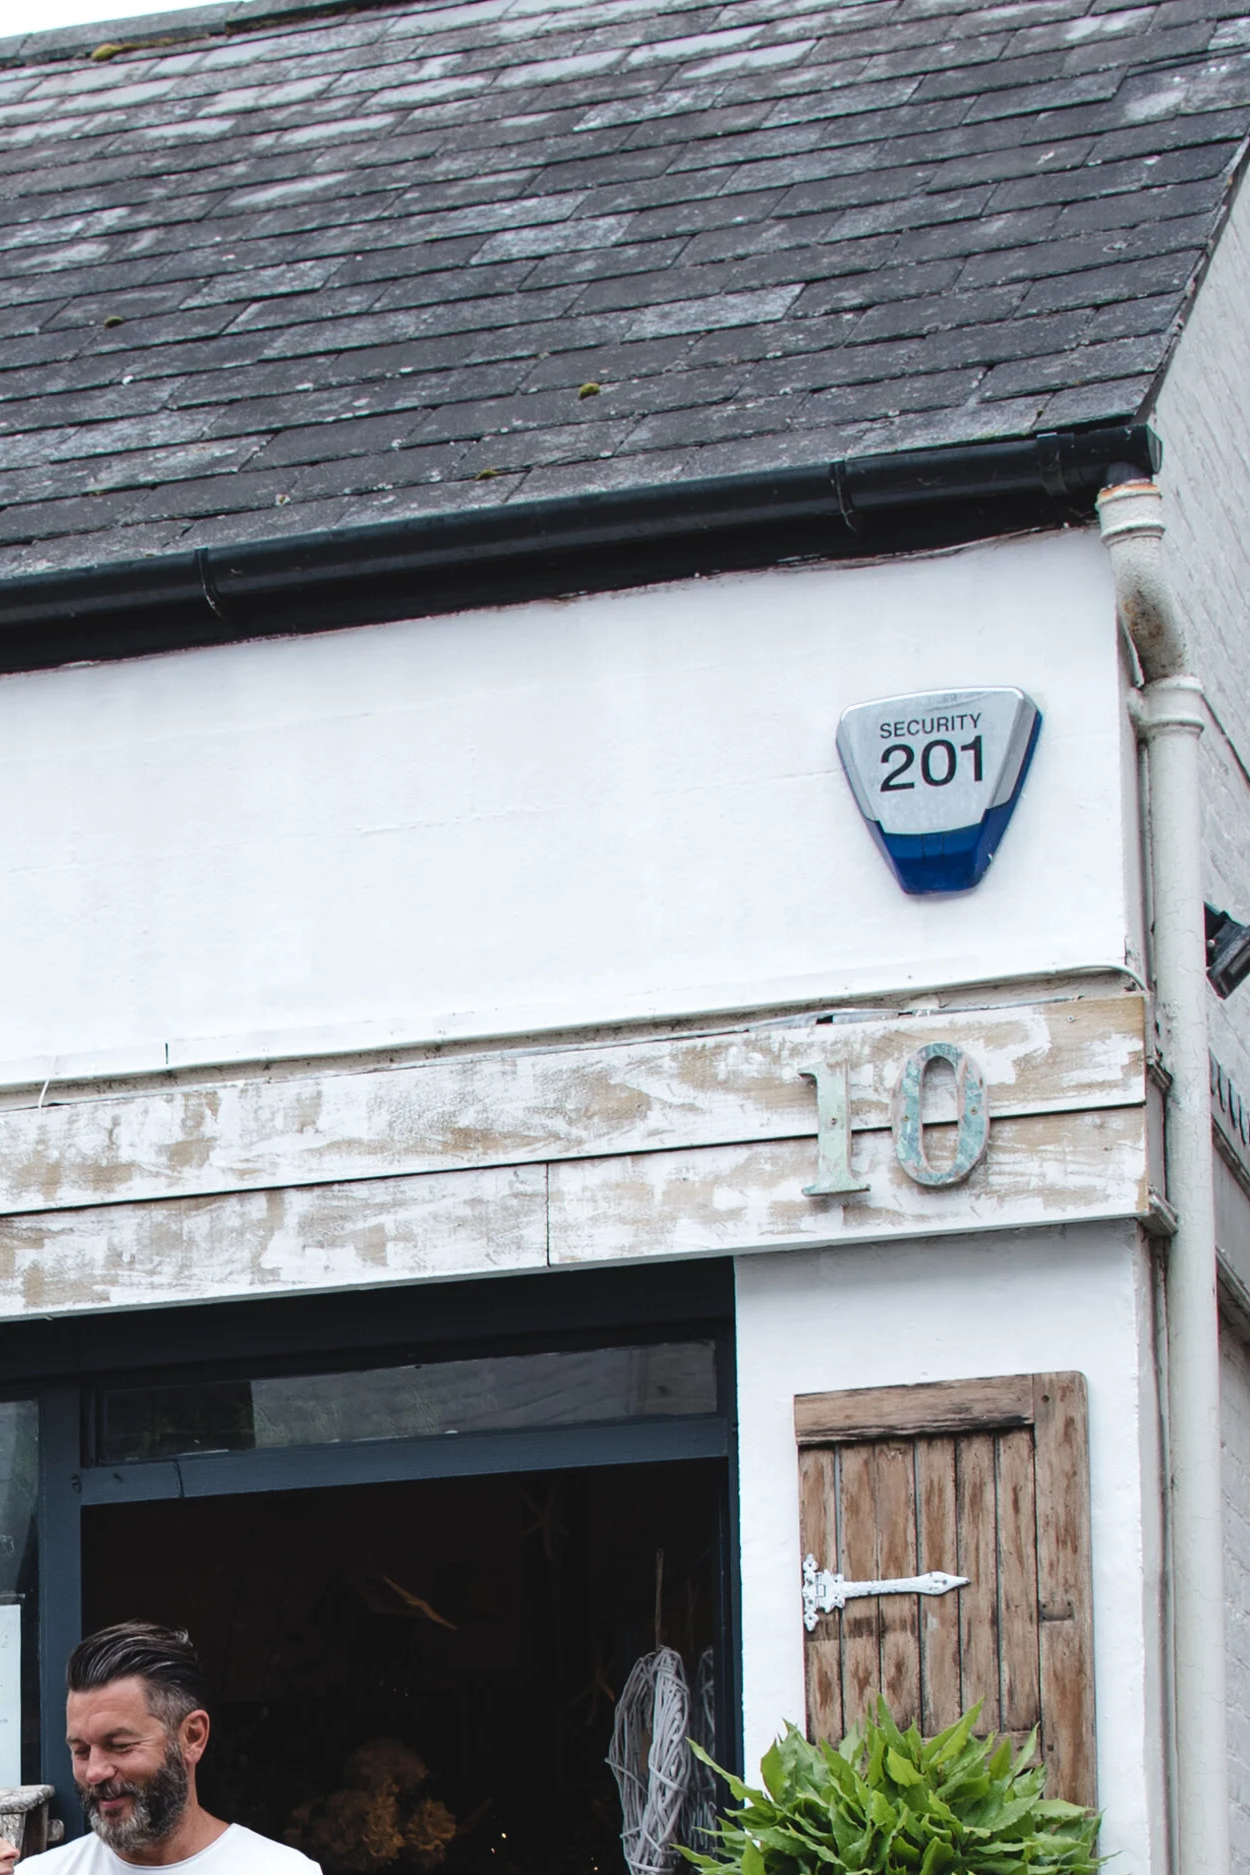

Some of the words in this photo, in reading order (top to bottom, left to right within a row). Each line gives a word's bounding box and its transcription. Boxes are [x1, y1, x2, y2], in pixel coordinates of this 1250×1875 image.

[879, 712, 982, 739] SECURITY
[880, 735, 983, 792] 201
[797, 1041, 990, 1197] 10
